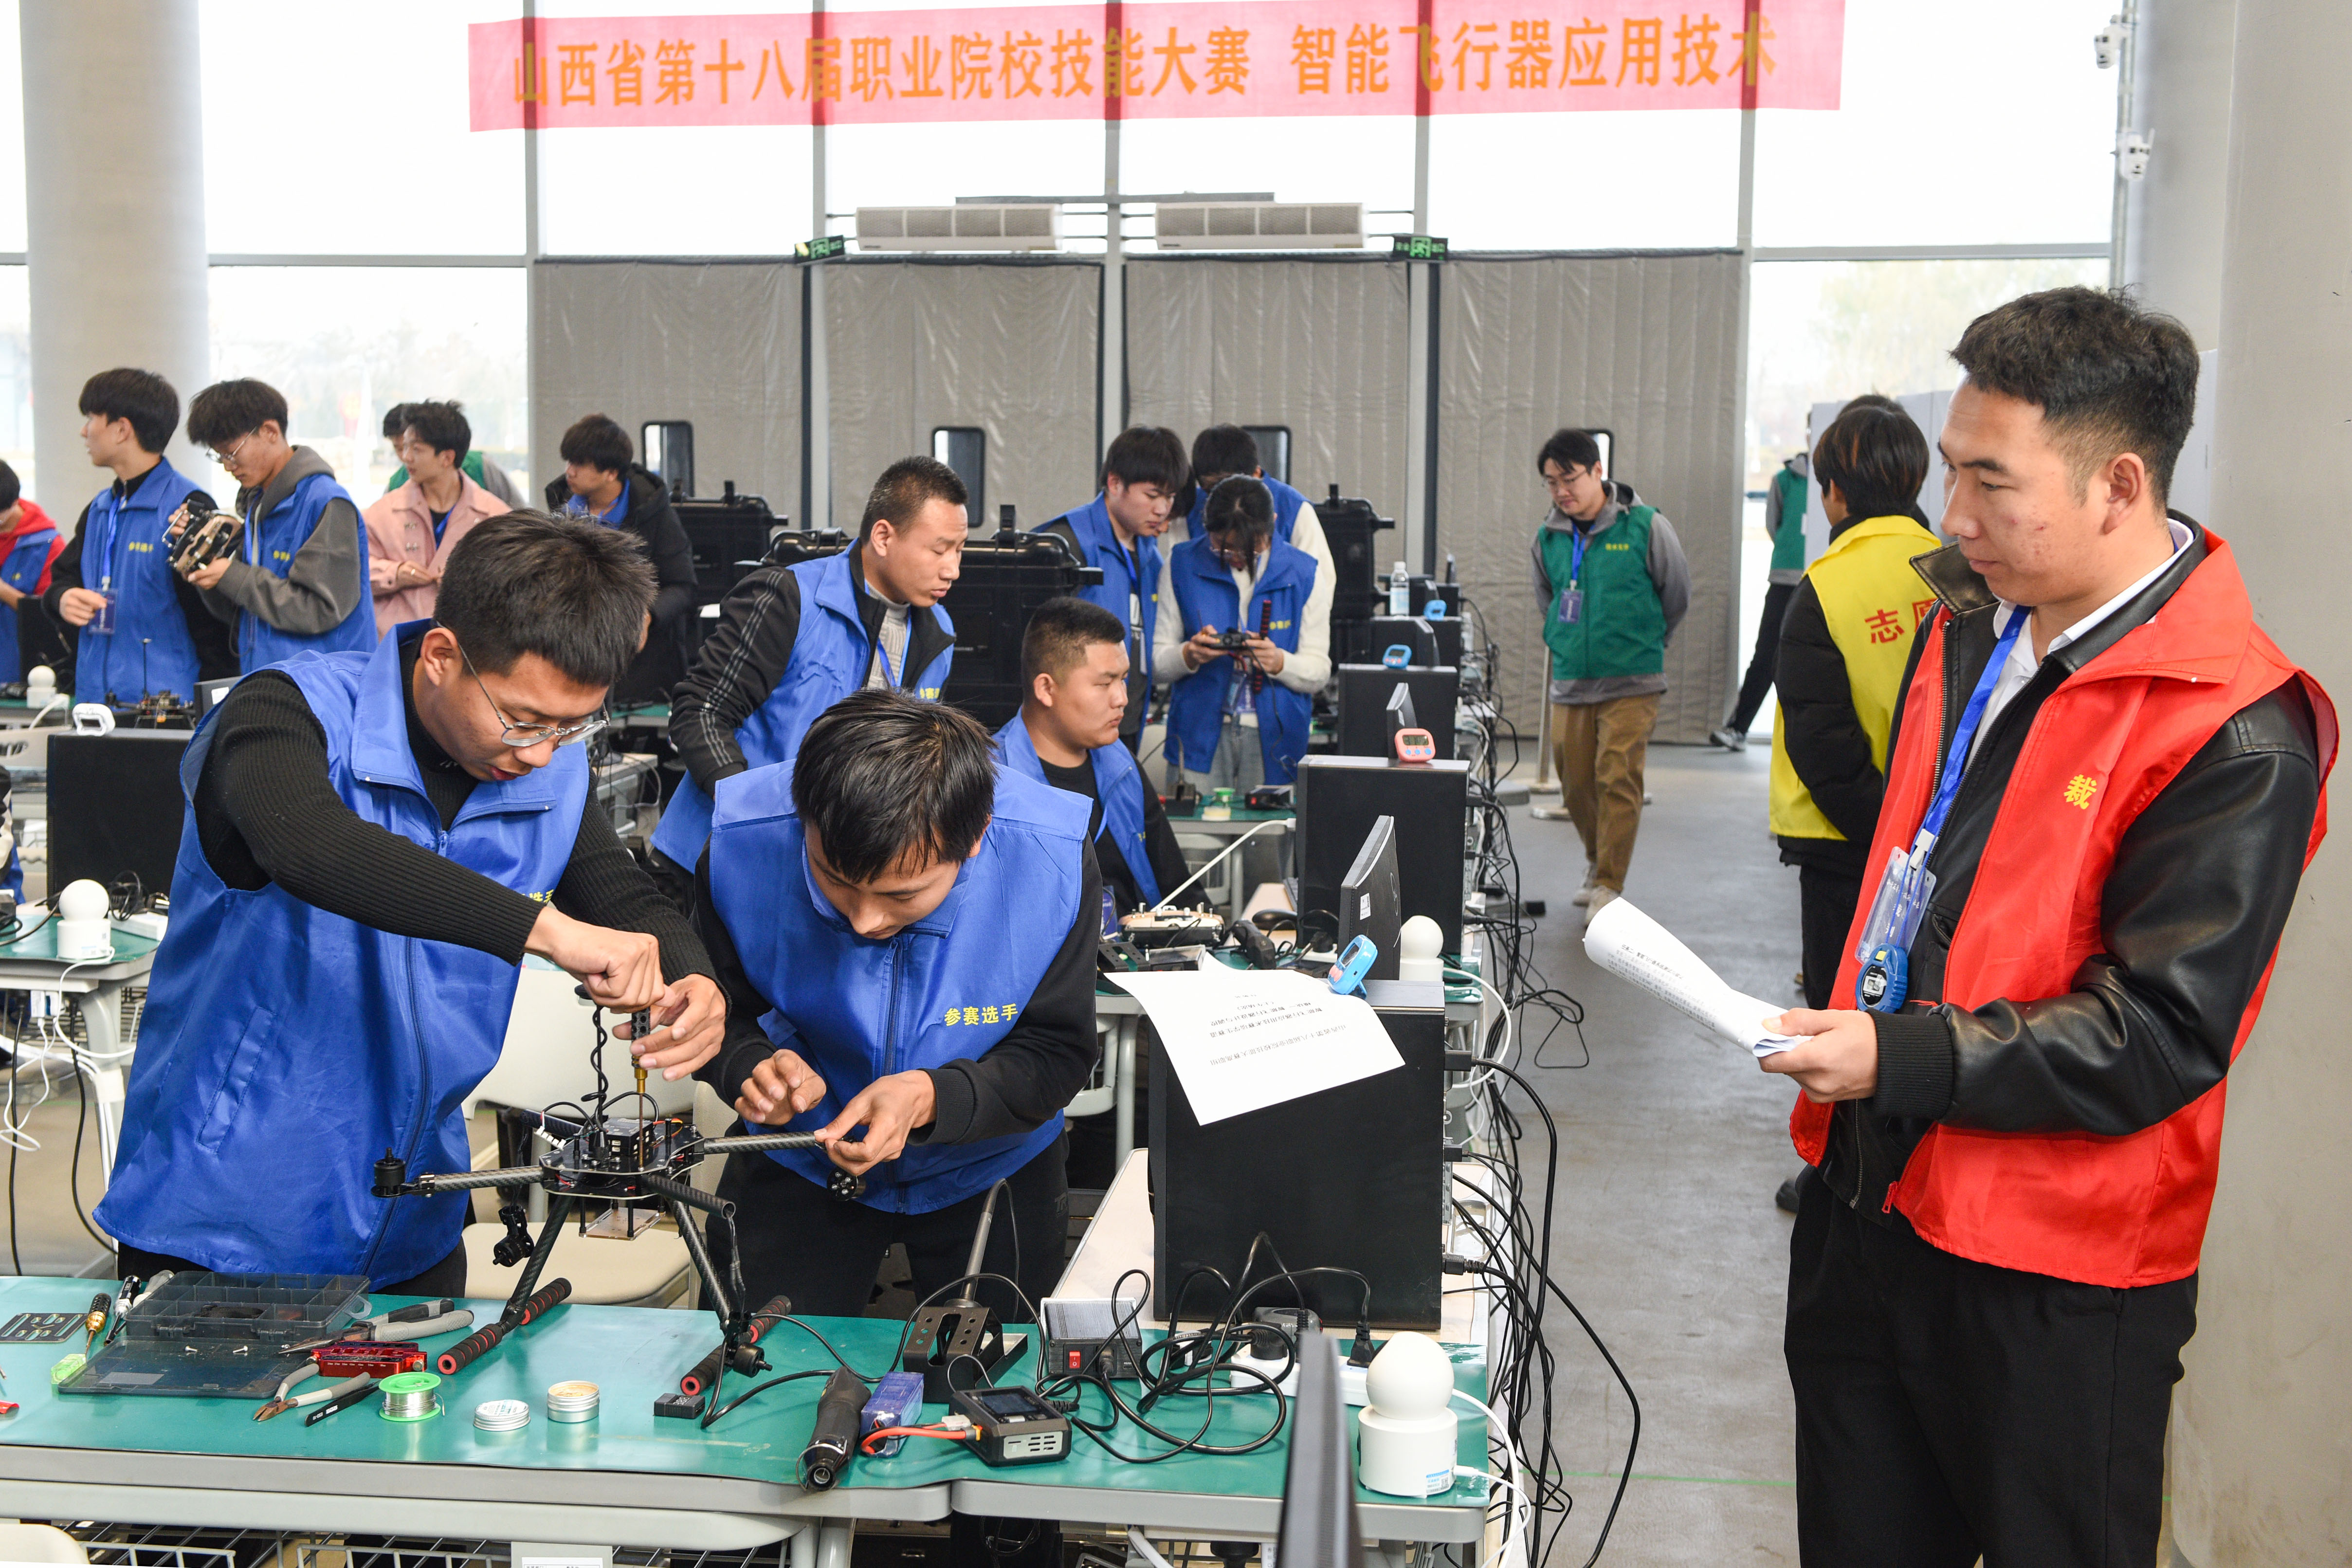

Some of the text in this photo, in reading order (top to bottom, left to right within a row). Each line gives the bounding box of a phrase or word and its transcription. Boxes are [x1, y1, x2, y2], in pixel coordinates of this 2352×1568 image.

[514, 12, 1777, 107] 山西省第十八届职业院校技能大赛 智能飞行器应用技术
[2064, 774, 2097, 810] 裁
[944, 1003, 1018, 1027] 参赛选手
